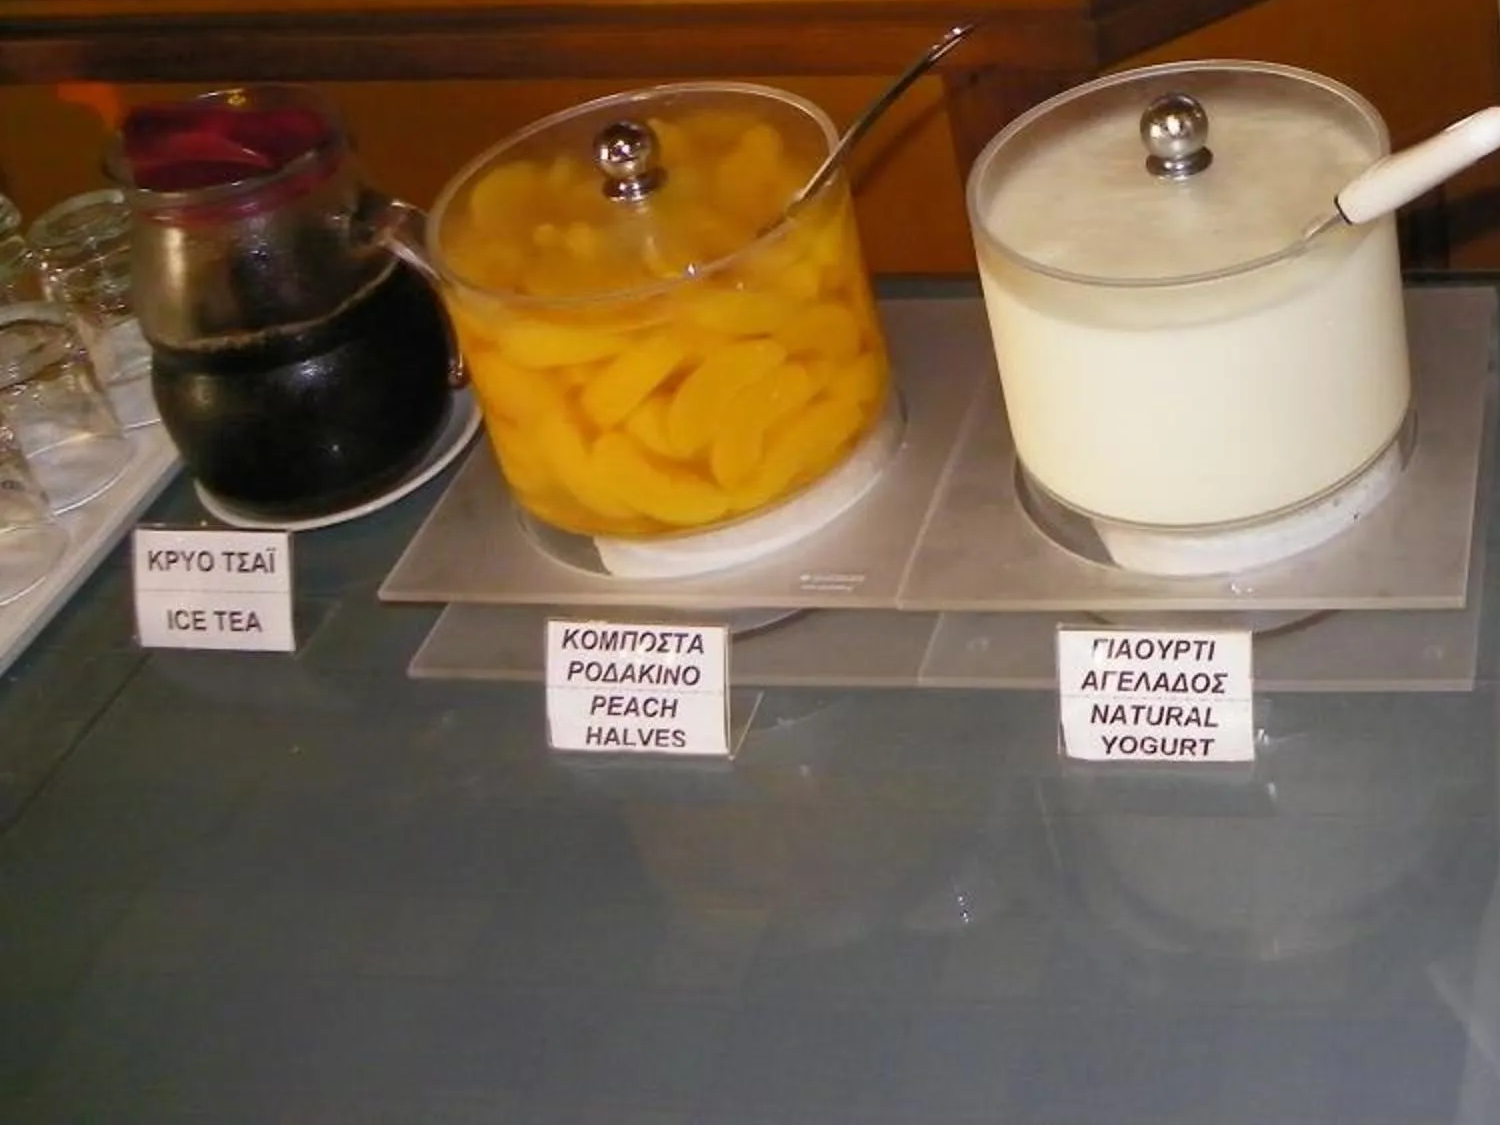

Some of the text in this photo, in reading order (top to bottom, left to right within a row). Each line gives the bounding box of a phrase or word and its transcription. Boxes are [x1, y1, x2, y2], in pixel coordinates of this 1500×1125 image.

[148, 547, 276, 574] ΚΡΥΟ ΤΣΑΪ
[167, 609, 263, 633] ICE TEA
[561, 628, 705, 655] ΚΟΜΠΟΣΤΑ
[1092, 638, 1216, 662] ΓΙΑΟΥΡΤΙ
[567, 660, 701, 686] ΡΟΔΑΚΙΝΟ
[1081, 670, 1229, 695] ΑΓΕΛΑΔΟΣ
[589, 695, 679, 718] PEACH
[1090, 703, 1220, 728] NATURAL
[585, 726, 687, 748] HALVES
[1101, 735, 1216, 757] YOGURT
